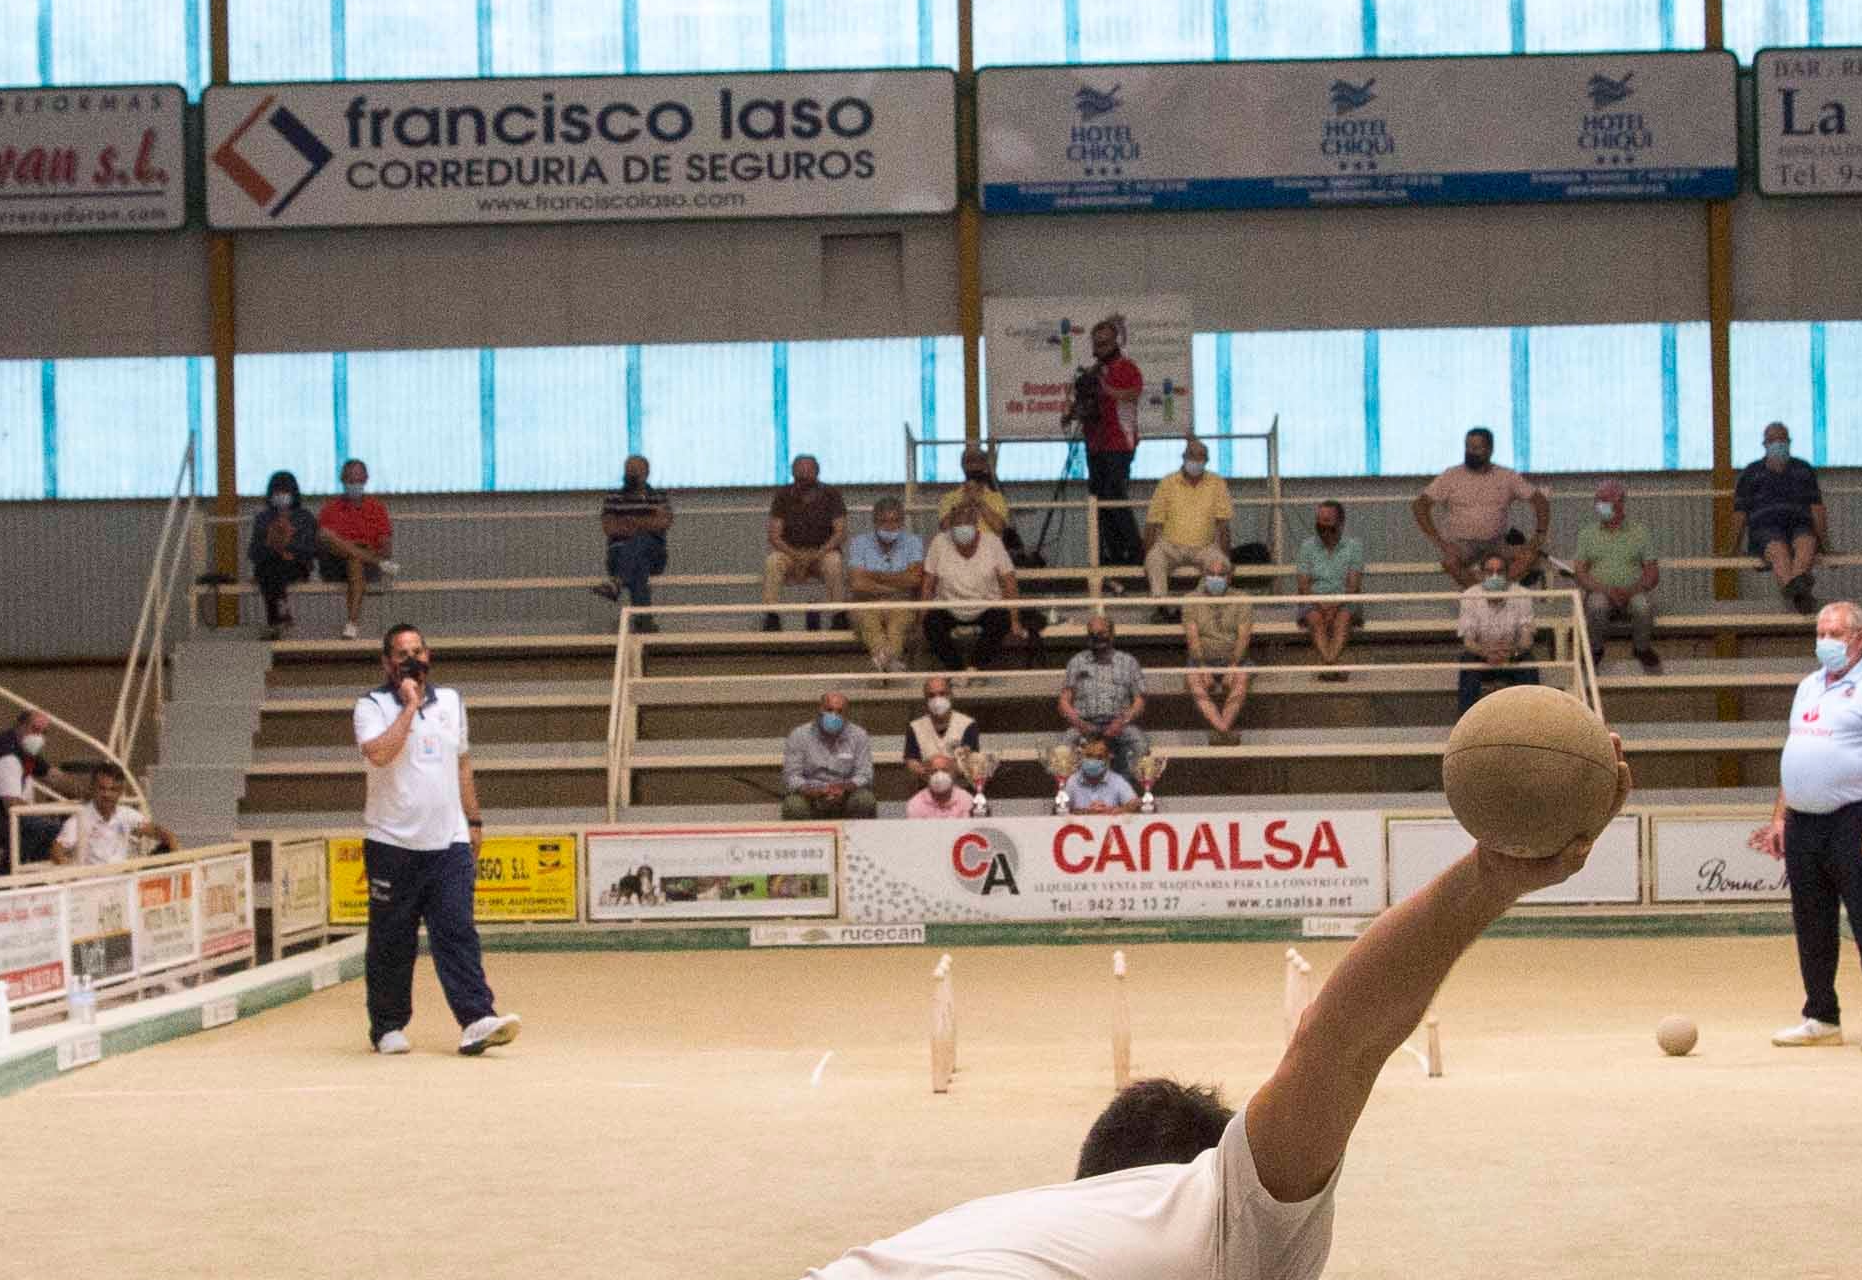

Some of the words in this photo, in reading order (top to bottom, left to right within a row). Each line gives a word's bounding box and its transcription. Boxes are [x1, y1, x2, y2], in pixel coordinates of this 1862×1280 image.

[1774, 60, 1822, 78] BAR
[345, 93, 695, 150] francisco
[718, 87, 875, 140] laso
[1777, 86, 1848, 136] La
[1070, 125, 1133, 144] HOTEL
[1323, 121, 1388, 140] HOTEL
[1582, 114, 1646, 134] HOTEL
[1066, 141, 1141, 163] CHIQUI
[1320, 136, 1396, 158] CHIQUI
[1576, 130, 1653, 153] CHIQUI
[91, 126, 170, 187] s.l.
[345, 152, 607, 193] CORREDURIA
[621, 152, 672, 185] DE
[684, 148, 876, 183] SEGUROS
[1778, 164, 1826, 186] Tel.
[476, 188, 747, 213] www.franciscolaso.com
[1052, 819, 1349, 874] CANALSA
[1696, 856, 1769, 894] Bonne
[1088, 898, 1115, 912] 942
[1119, 897, 1136, 911] 32
[1141, 897, 1158, 911] 13
[1161, 896, 1181, 910] 27
[840, 925, 923, 942] rucecan
